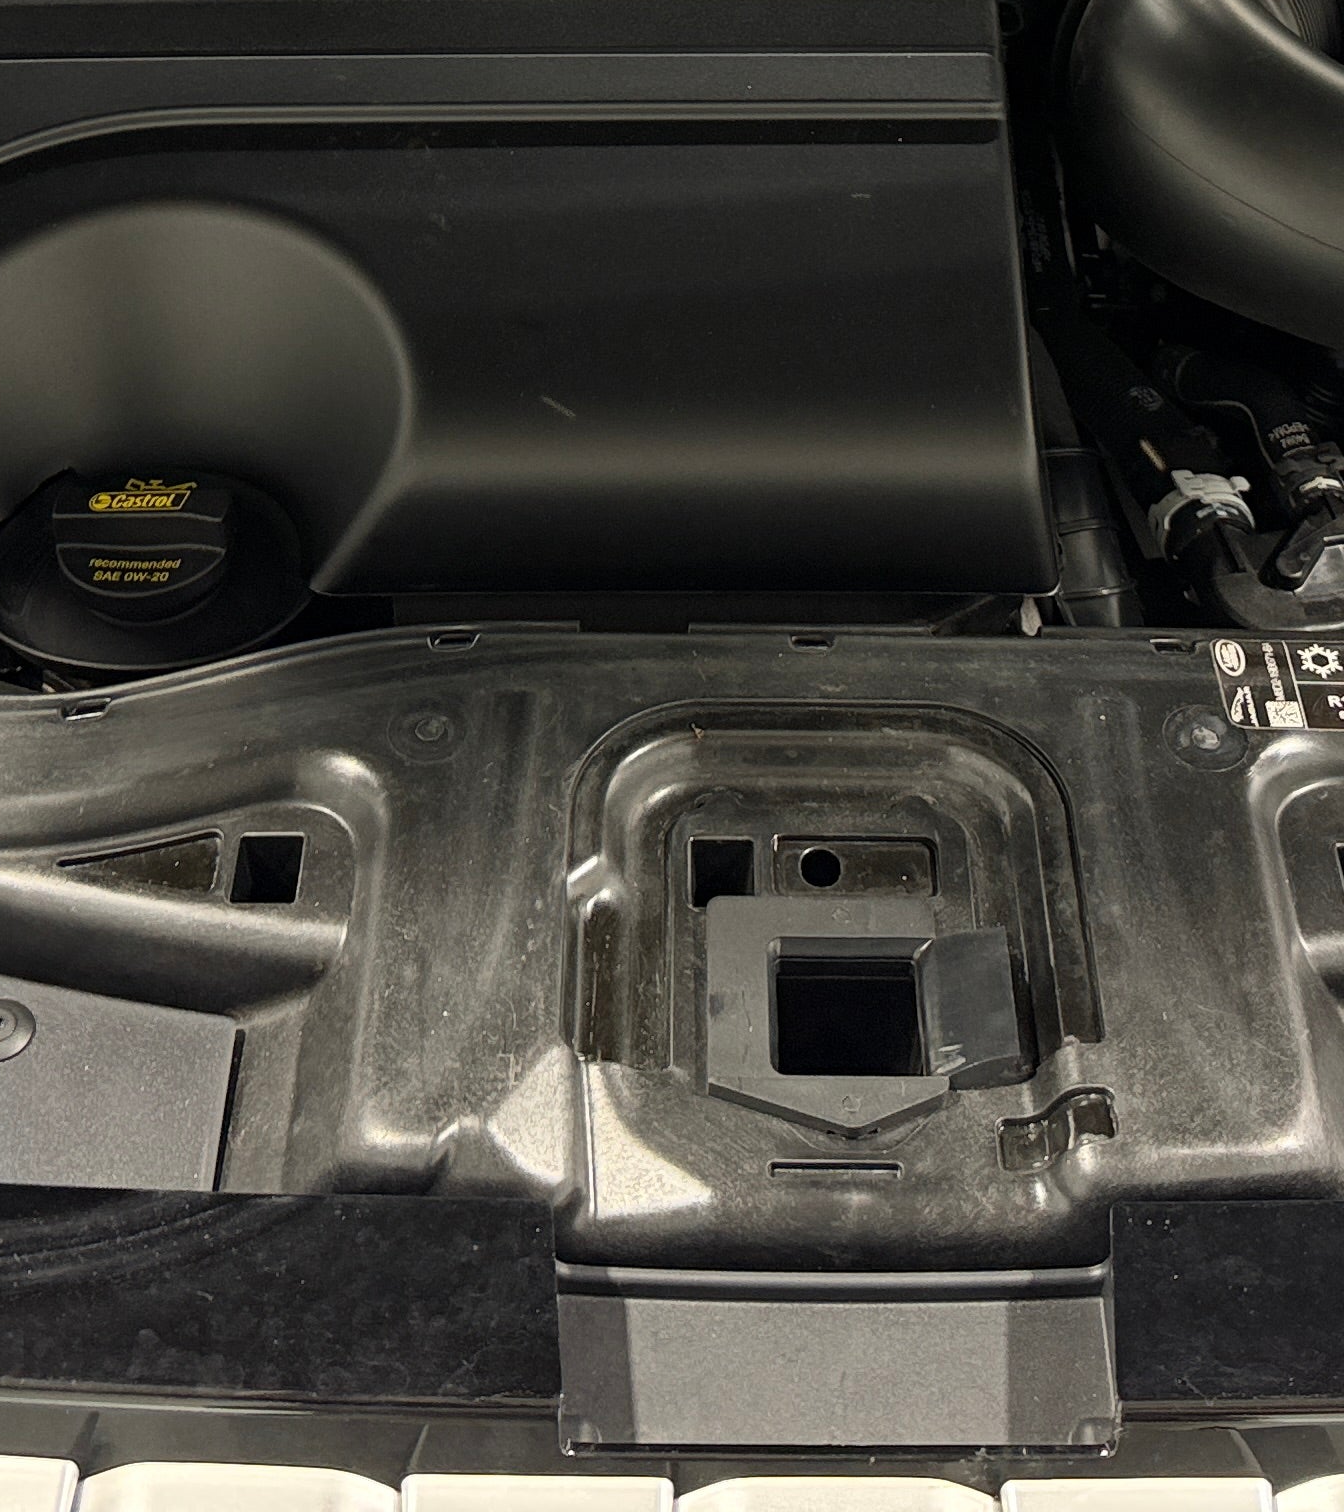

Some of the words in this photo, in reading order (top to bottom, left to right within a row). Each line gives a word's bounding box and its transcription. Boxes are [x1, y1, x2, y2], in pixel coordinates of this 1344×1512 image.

[111, 493, 176, 508] Castrol
[88, 558, 182, 569] recommended
[93, 570, 122, 581] SAE
[124, 571, 170, 582] 0W-20
